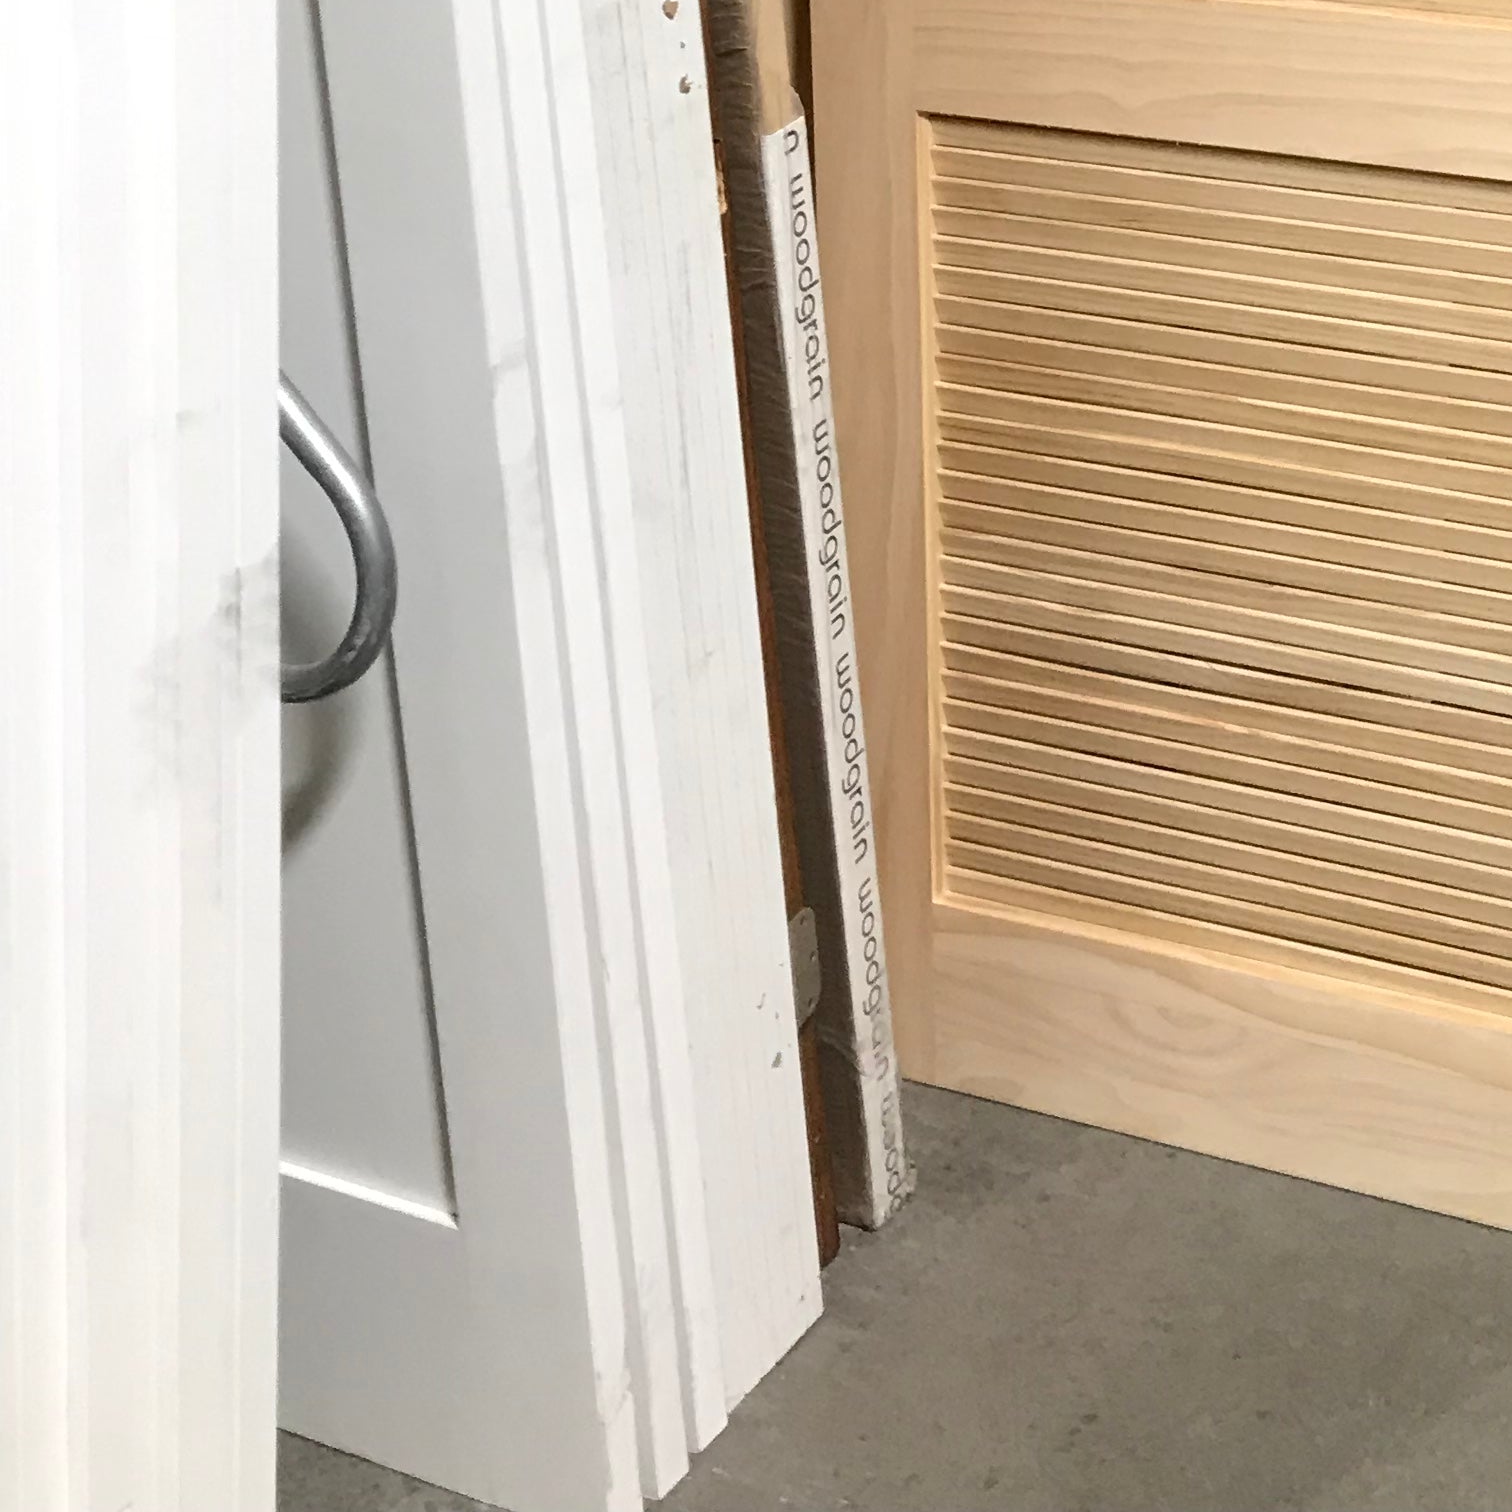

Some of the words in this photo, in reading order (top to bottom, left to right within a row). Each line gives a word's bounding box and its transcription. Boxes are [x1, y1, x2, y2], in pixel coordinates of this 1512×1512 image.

[790, 173, 826, 400] woodgrain
[812, 419, 848, 639] woodgrain
[835, 653, 870, 864] woodgrain
